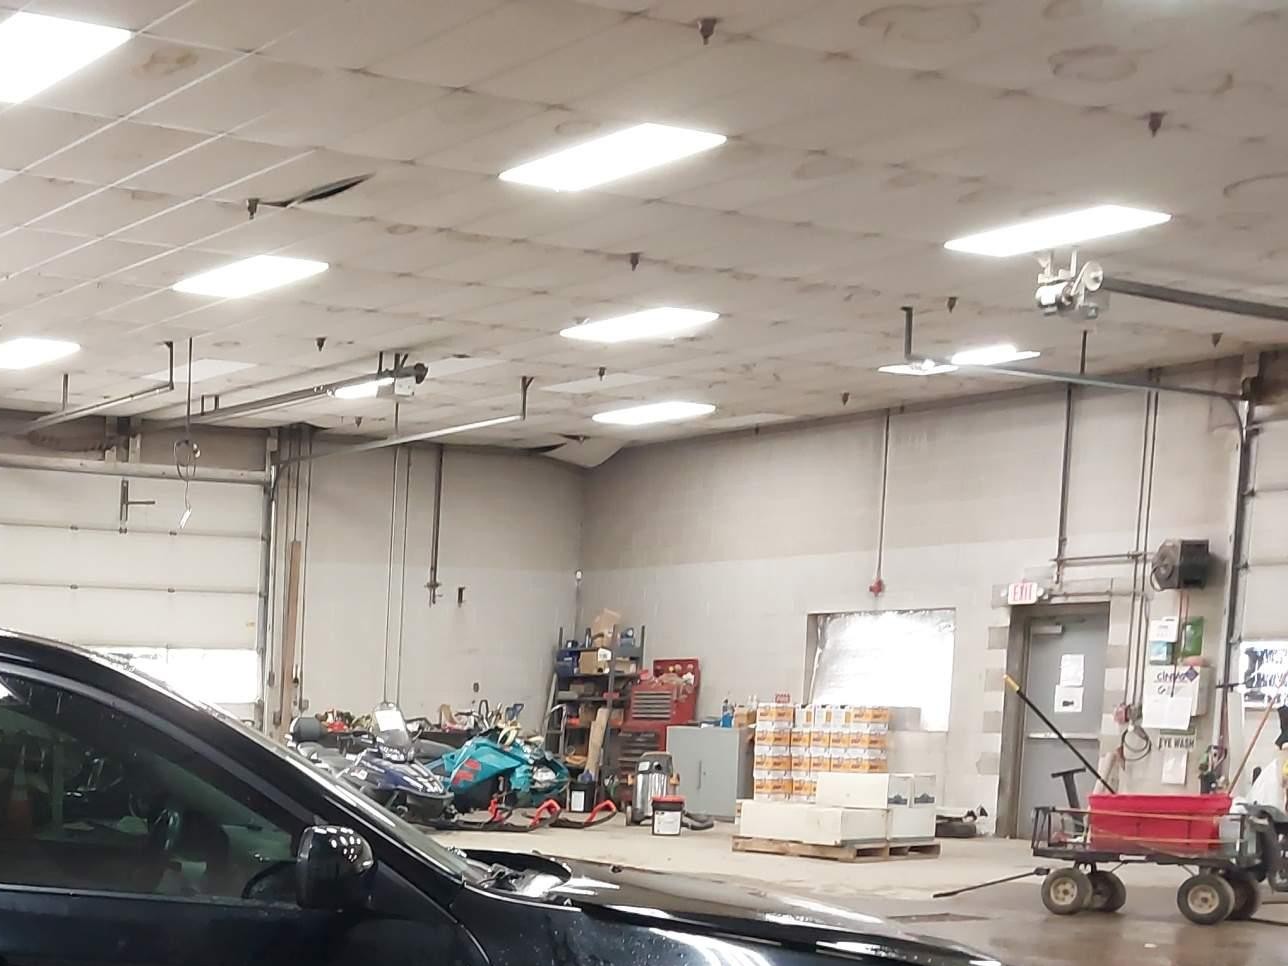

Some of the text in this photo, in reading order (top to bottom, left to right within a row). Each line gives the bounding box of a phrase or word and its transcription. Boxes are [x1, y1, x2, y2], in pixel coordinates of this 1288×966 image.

[1013, 582, 1033, 601] EXIT
[1158, 737, 1195, 750] EYE WASH
